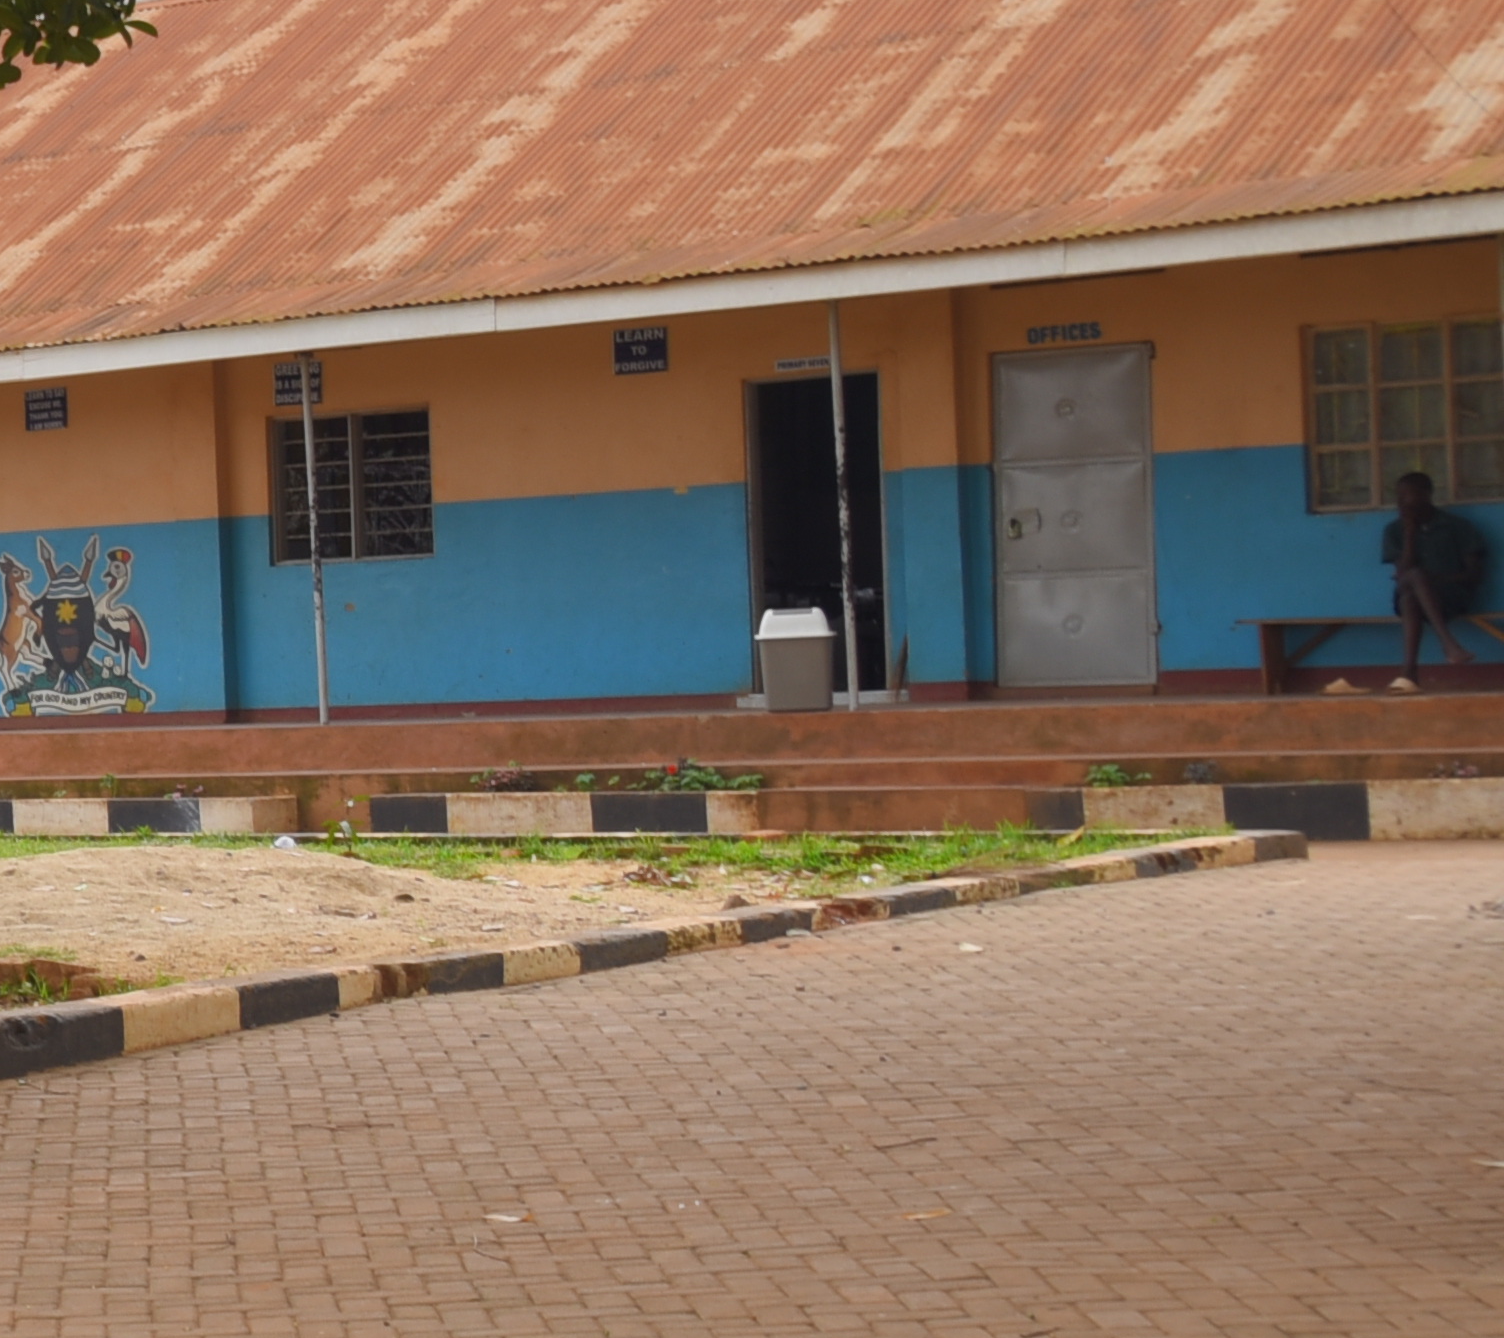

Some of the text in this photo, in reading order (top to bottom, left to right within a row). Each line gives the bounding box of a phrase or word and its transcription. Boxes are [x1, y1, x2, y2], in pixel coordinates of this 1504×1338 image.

[615, 328, 664, 343] LEARN
[1027, 321, 1102, 344] OFFICES
[630, 345, 647, 356] TO
[44, 693, 60, 702] GOD
[61, 695, 78, 706] AND
[80, 696, 91, 705] MY
